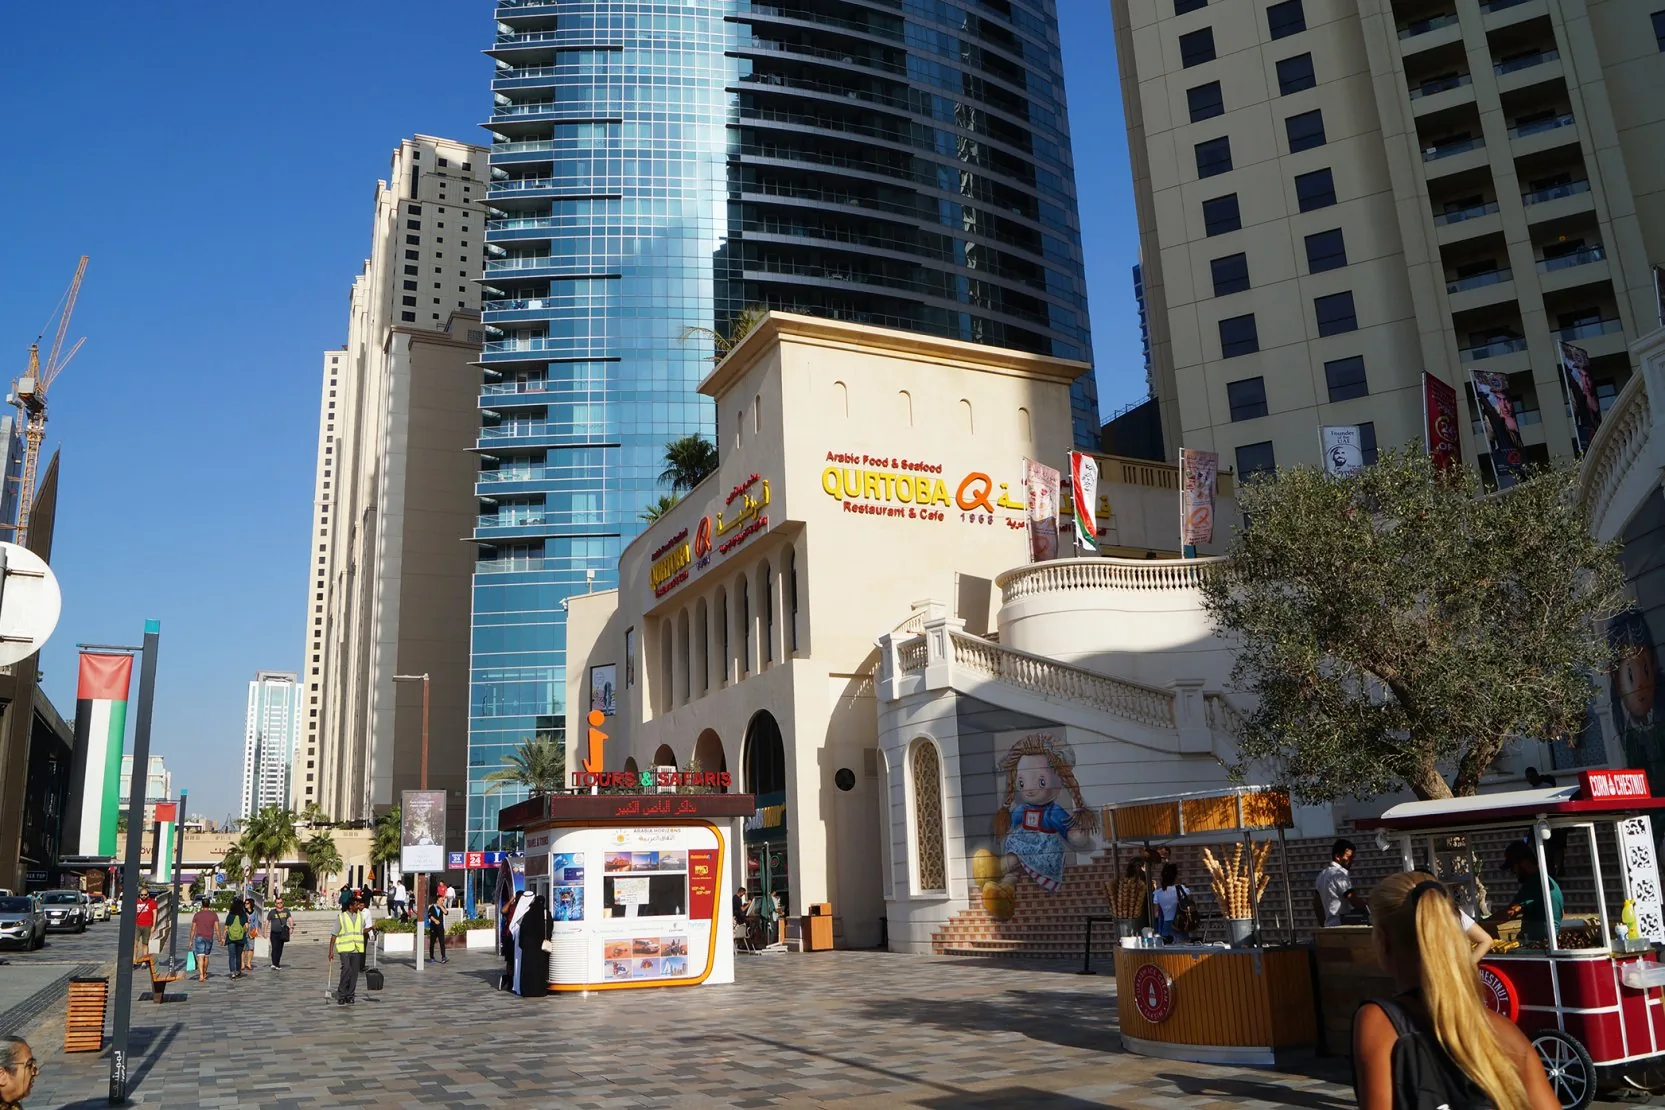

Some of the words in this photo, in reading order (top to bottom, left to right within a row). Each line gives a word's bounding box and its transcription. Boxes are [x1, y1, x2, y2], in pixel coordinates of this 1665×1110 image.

[826, 451, 860, 464] Arabic
[863, 455, 889, 468] Food
[891, 459, 899, 469] &
[901, 459, 942, 474] Seafood
[822, 466, 951, 507] QURTOBA
[956, 472, 994, 513] Q
[843, 501, 905, 518] Restaurant
[908, 508, 917, 519] &
[920, 508, 944, 522] Cafe
[572, 771, 636, 787] TOURS
[640, 771, 653, 787] &
[658, 771, 732, 787] SAFARIS
[1589, 775, 1610, 796] CORN
[1614, 774, 1647, 795] CHESTNUT
[1480, 969, 1509, 1002] HESTNUT
